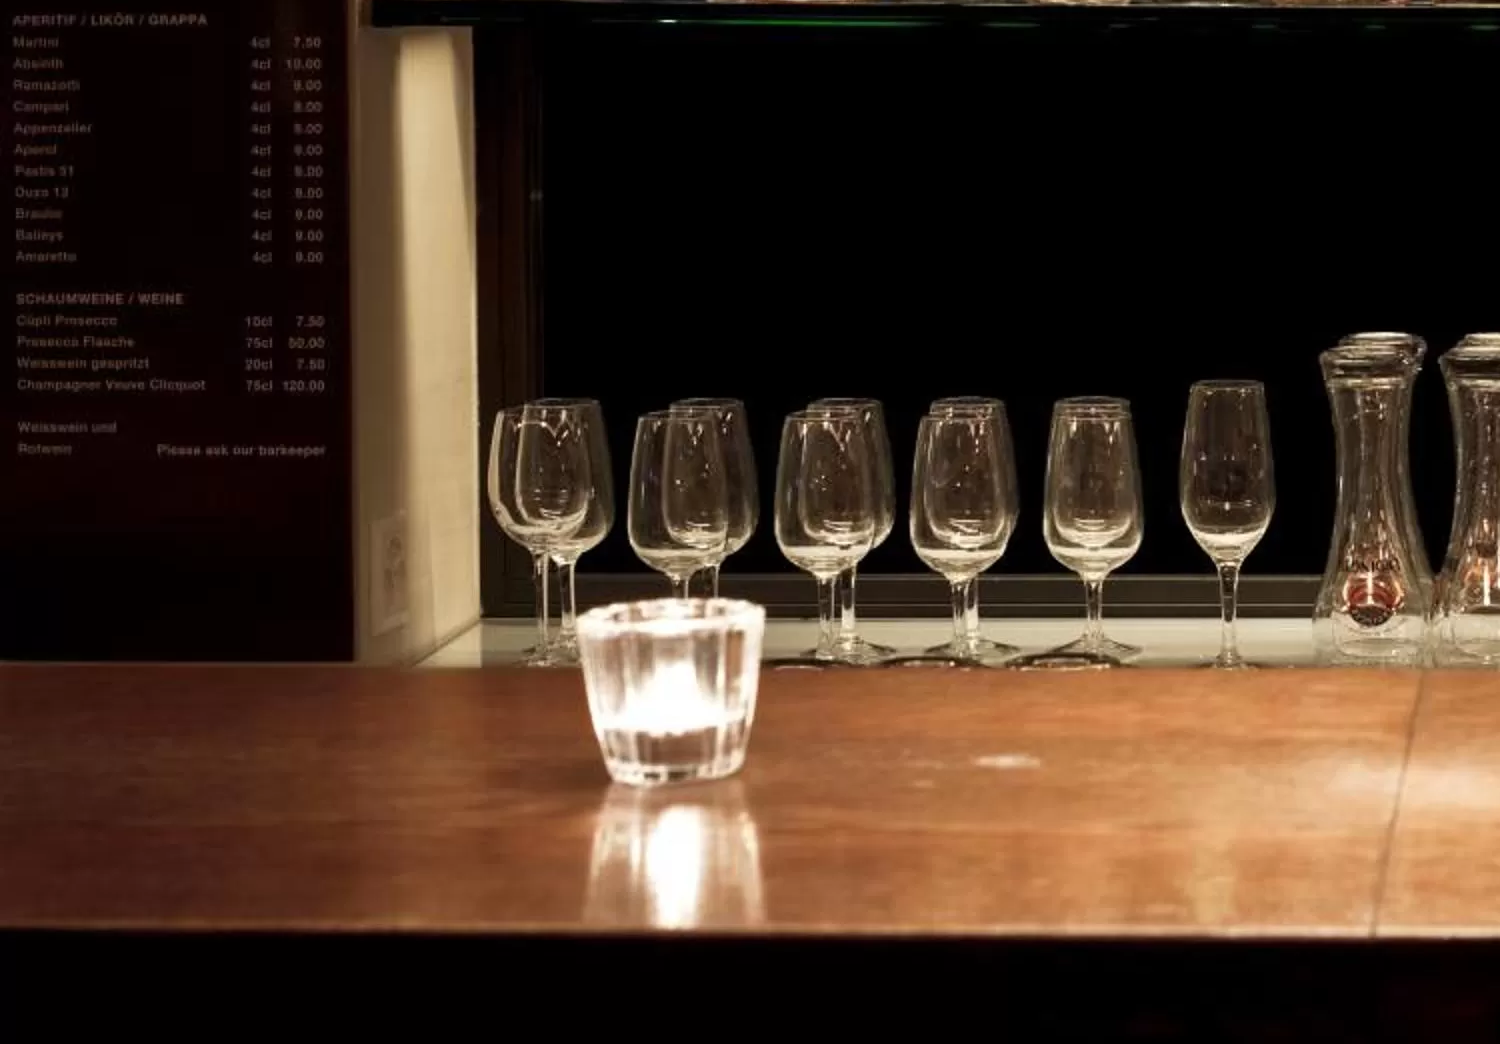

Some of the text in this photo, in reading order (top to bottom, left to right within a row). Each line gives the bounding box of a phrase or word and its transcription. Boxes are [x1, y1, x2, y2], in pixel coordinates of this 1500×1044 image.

[12, 14, 77, 27] APERITIF
[148, 14, 208, 27] GRAPPA
[15, 292, 184, 305] SCHAUMWEINE WEINE
